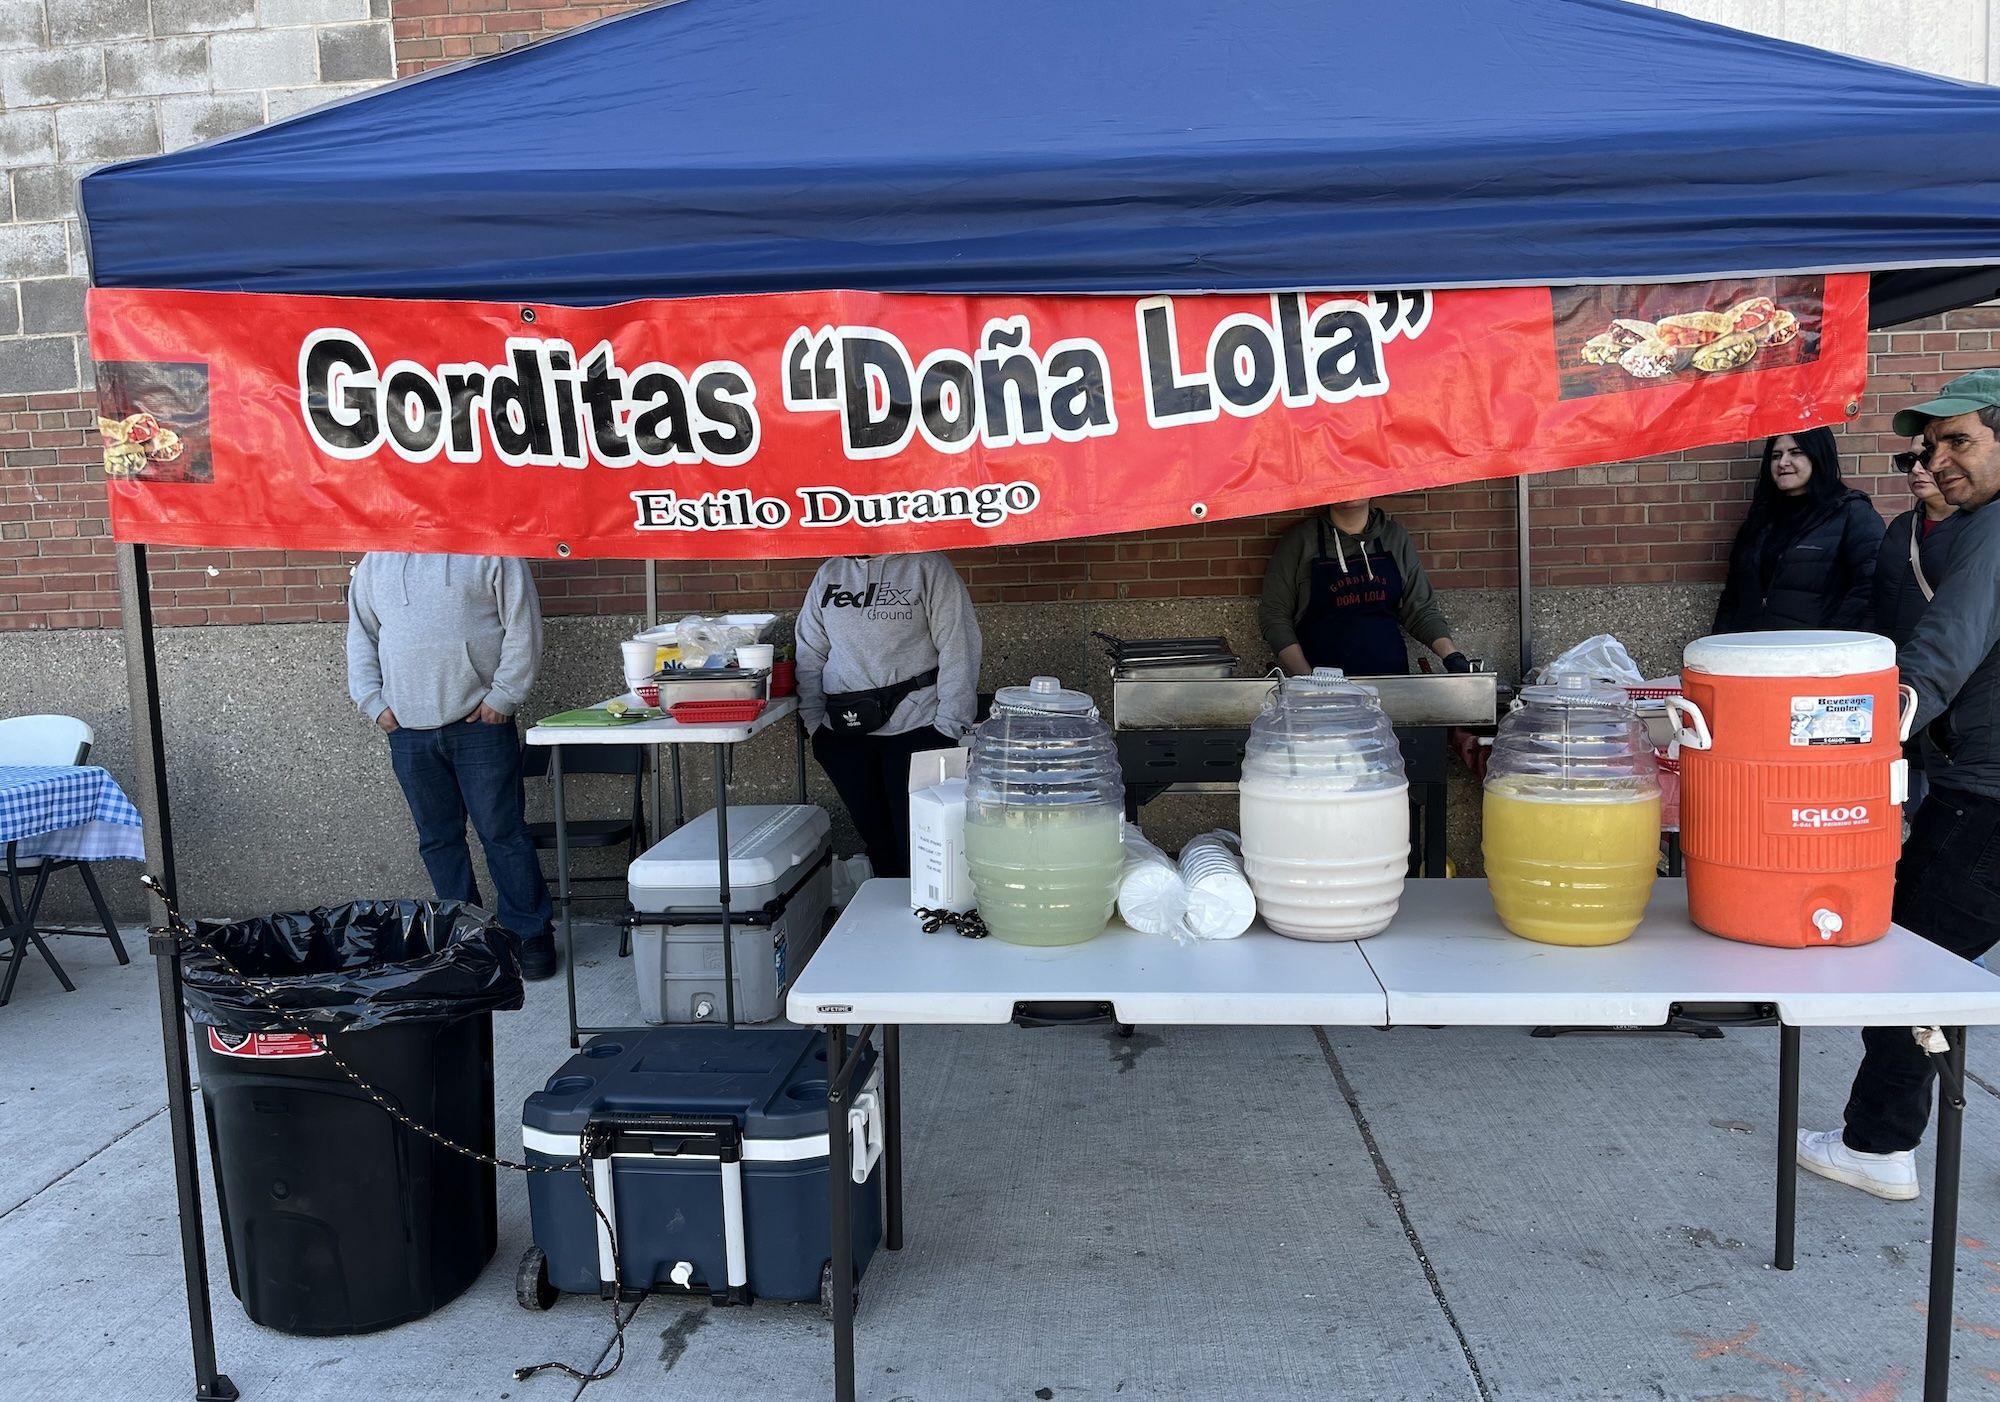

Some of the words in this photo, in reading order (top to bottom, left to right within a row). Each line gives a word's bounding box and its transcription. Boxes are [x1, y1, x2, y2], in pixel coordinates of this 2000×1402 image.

[299, 328, 759, 468] Gorditas
[782, 316, 1117, 459] “Doña
[631, 490, 792, 532] Estilo
[796, 482, 1039, 527] Durango
[867, 608, 913, 620] Ground
[1818, 698, 1867, 706] Beverage
[1792, 806, 1867, 828] IGLOO
